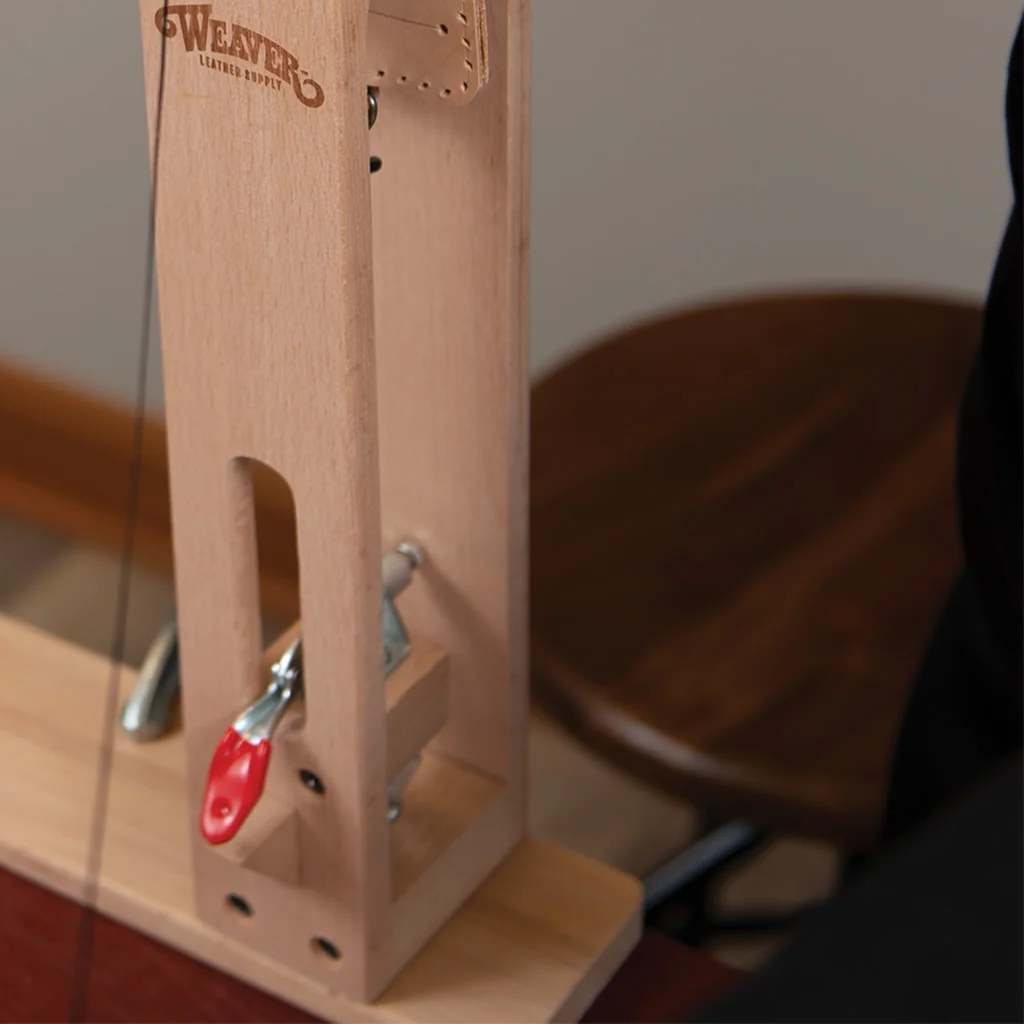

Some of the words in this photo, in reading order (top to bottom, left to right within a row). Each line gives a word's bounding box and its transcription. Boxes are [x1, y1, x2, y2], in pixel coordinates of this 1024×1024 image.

[154, 3, 325, 108] WEAVER
[199, 54, 242, 77] LEATHER
[244, 69, 282, 91] SUPPLY
